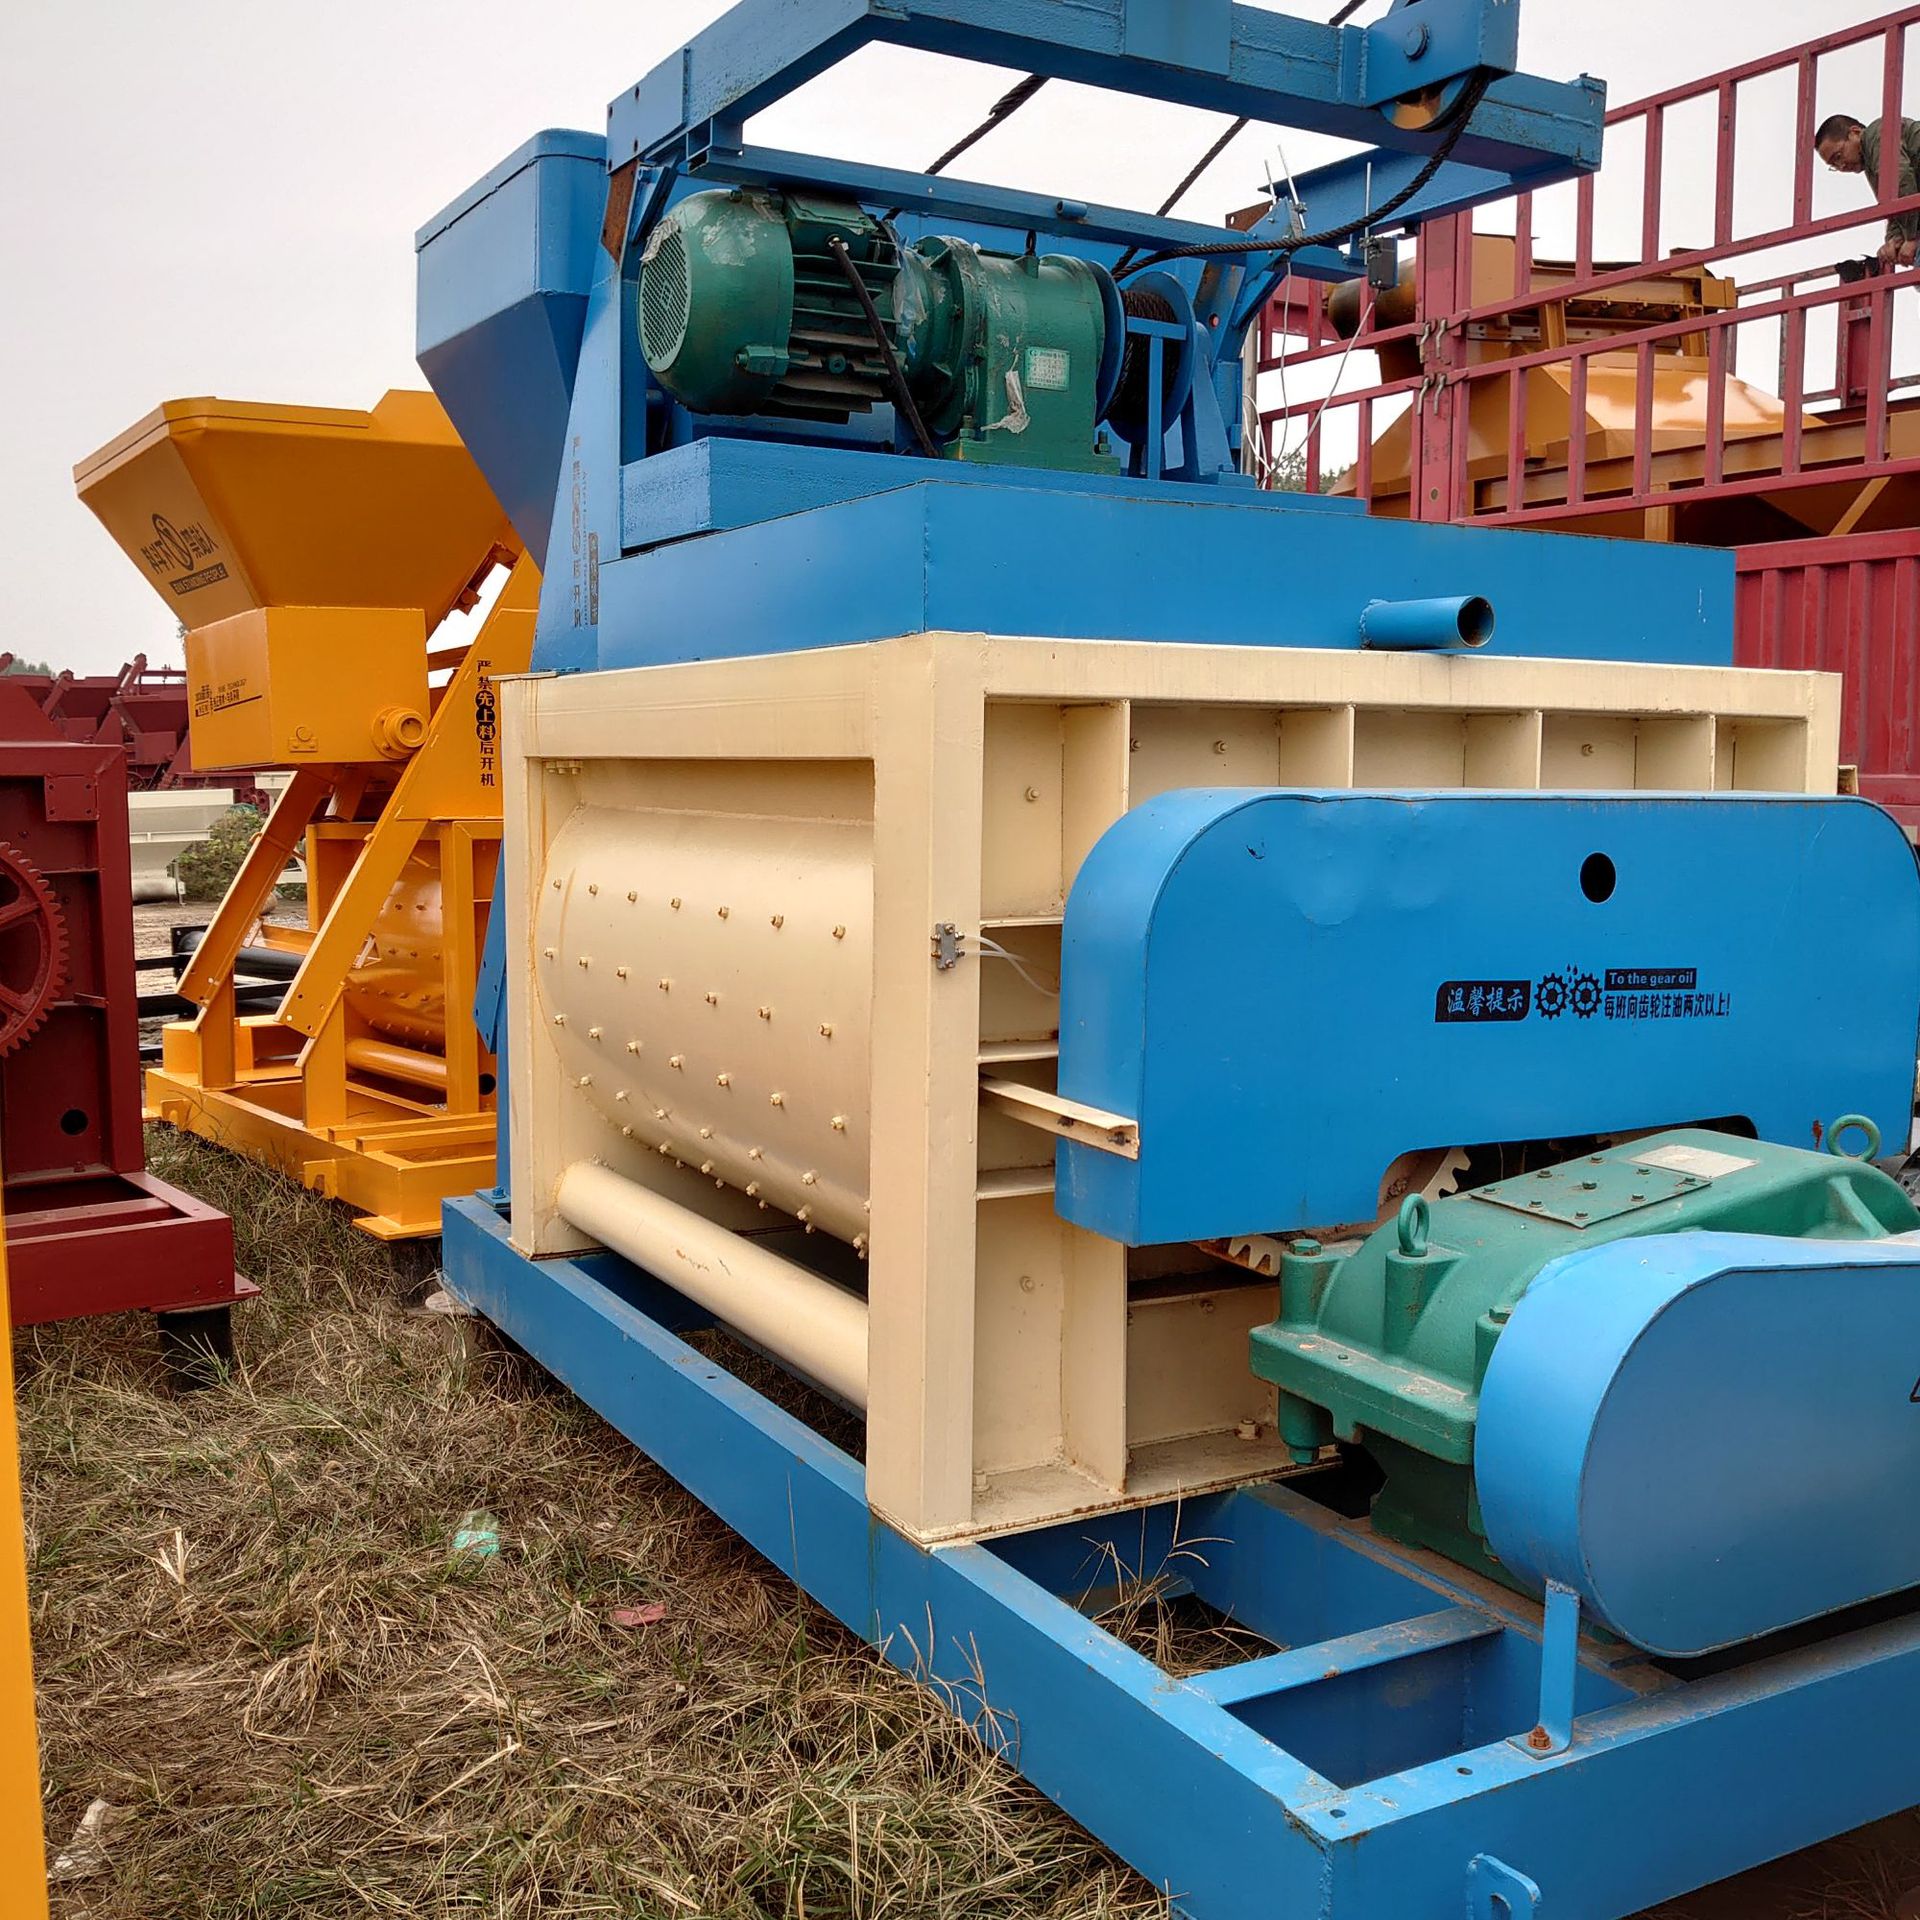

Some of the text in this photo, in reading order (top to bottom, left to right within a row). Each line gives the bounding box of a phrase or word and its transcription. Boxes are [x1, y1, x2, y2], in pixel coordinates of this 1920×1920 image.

[476, 659, 496, 787] 严禁先上料后开机
[1609, 971, 1693, 987] To the gear oil
[1447, 985, 1524, 1017] 温馨提示
